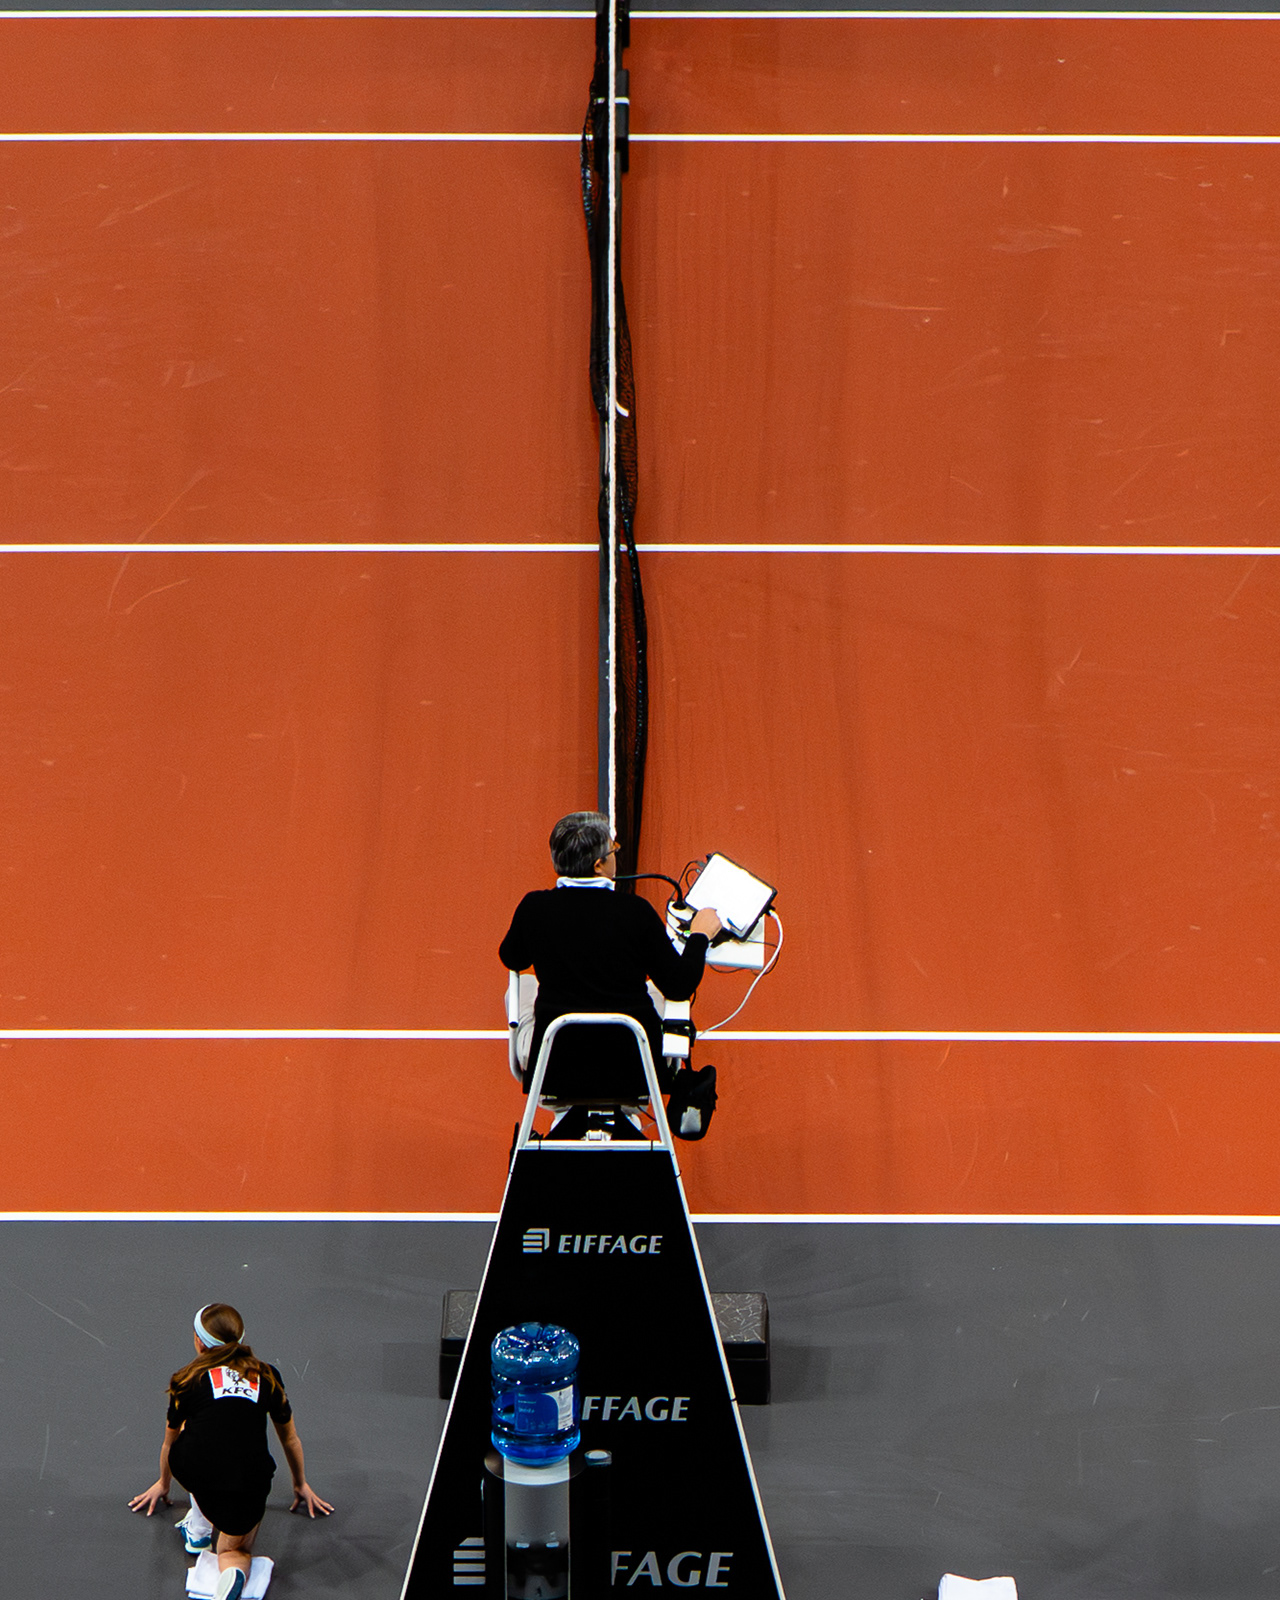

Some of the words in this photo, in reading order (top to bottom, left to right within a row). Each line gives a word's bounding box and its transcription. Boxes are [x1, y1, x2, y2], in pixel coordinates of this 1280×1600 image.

[558, 1234, 663, 1254] EIFFAGE
[222, 1386, 253, 1397] KFC
[581, 1396, 690, 1421] FFAGE
[611, 1551, 734, 1587] FAGE
